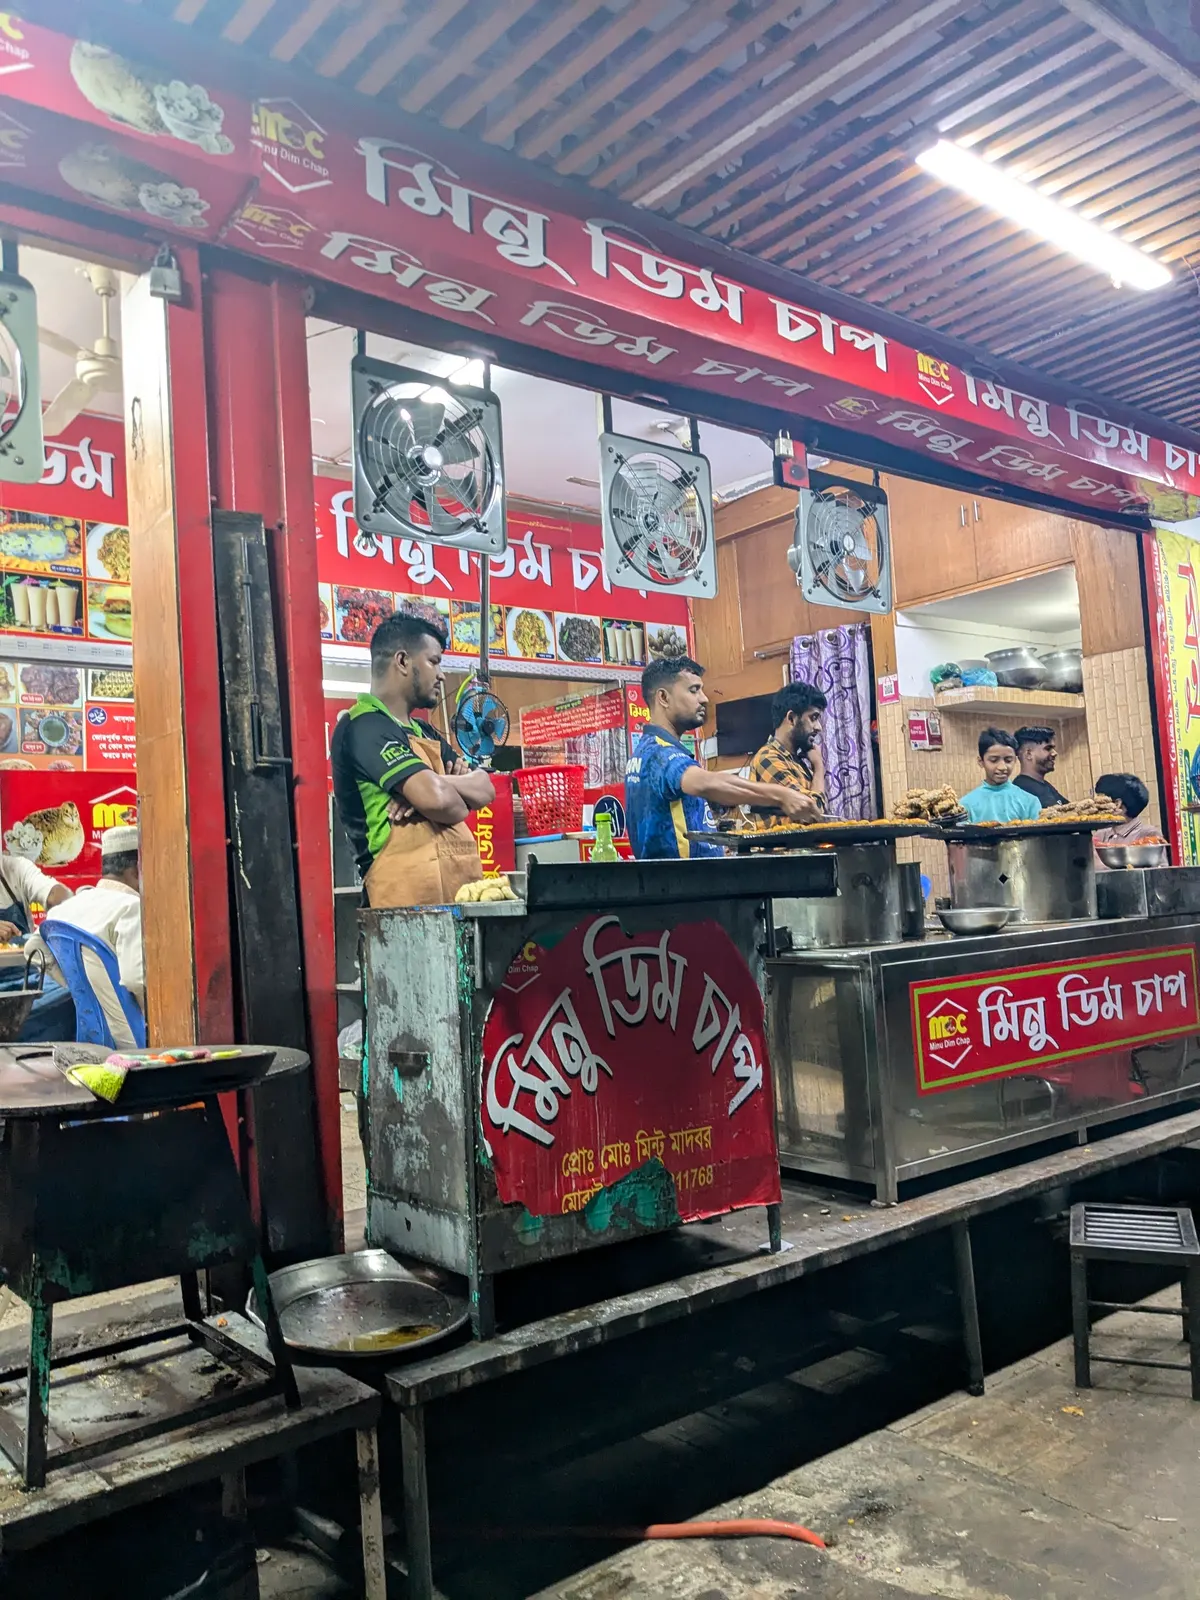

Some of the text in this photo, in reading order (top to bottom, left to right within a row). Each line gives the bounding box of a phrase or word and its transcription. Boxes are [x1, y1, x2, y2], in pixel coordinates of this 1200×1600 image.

[280, 147, 300, 165] Dim
[302, 158, 331, 178] Chap
[355, 136, 888, 373] মিনু ডিম চাপ
[319, 231, 815, 399] মিনু ডিম চাপ
[876, 410, 976, 461] মিনু
[975, 445, 1069, 483] ডিম
[961, 362, 1066, 448] মিনু
[1065, 399, 1149, 462] ডিম
[521, 964, 539, 973] Chap
[486, 914, 764, 1145] মিনু ডিম চাপ
[929, 1036, 971, 1051] Minu Dim Chap
[976, 970, 1188, 1052] মিনু ডিম চাপ
